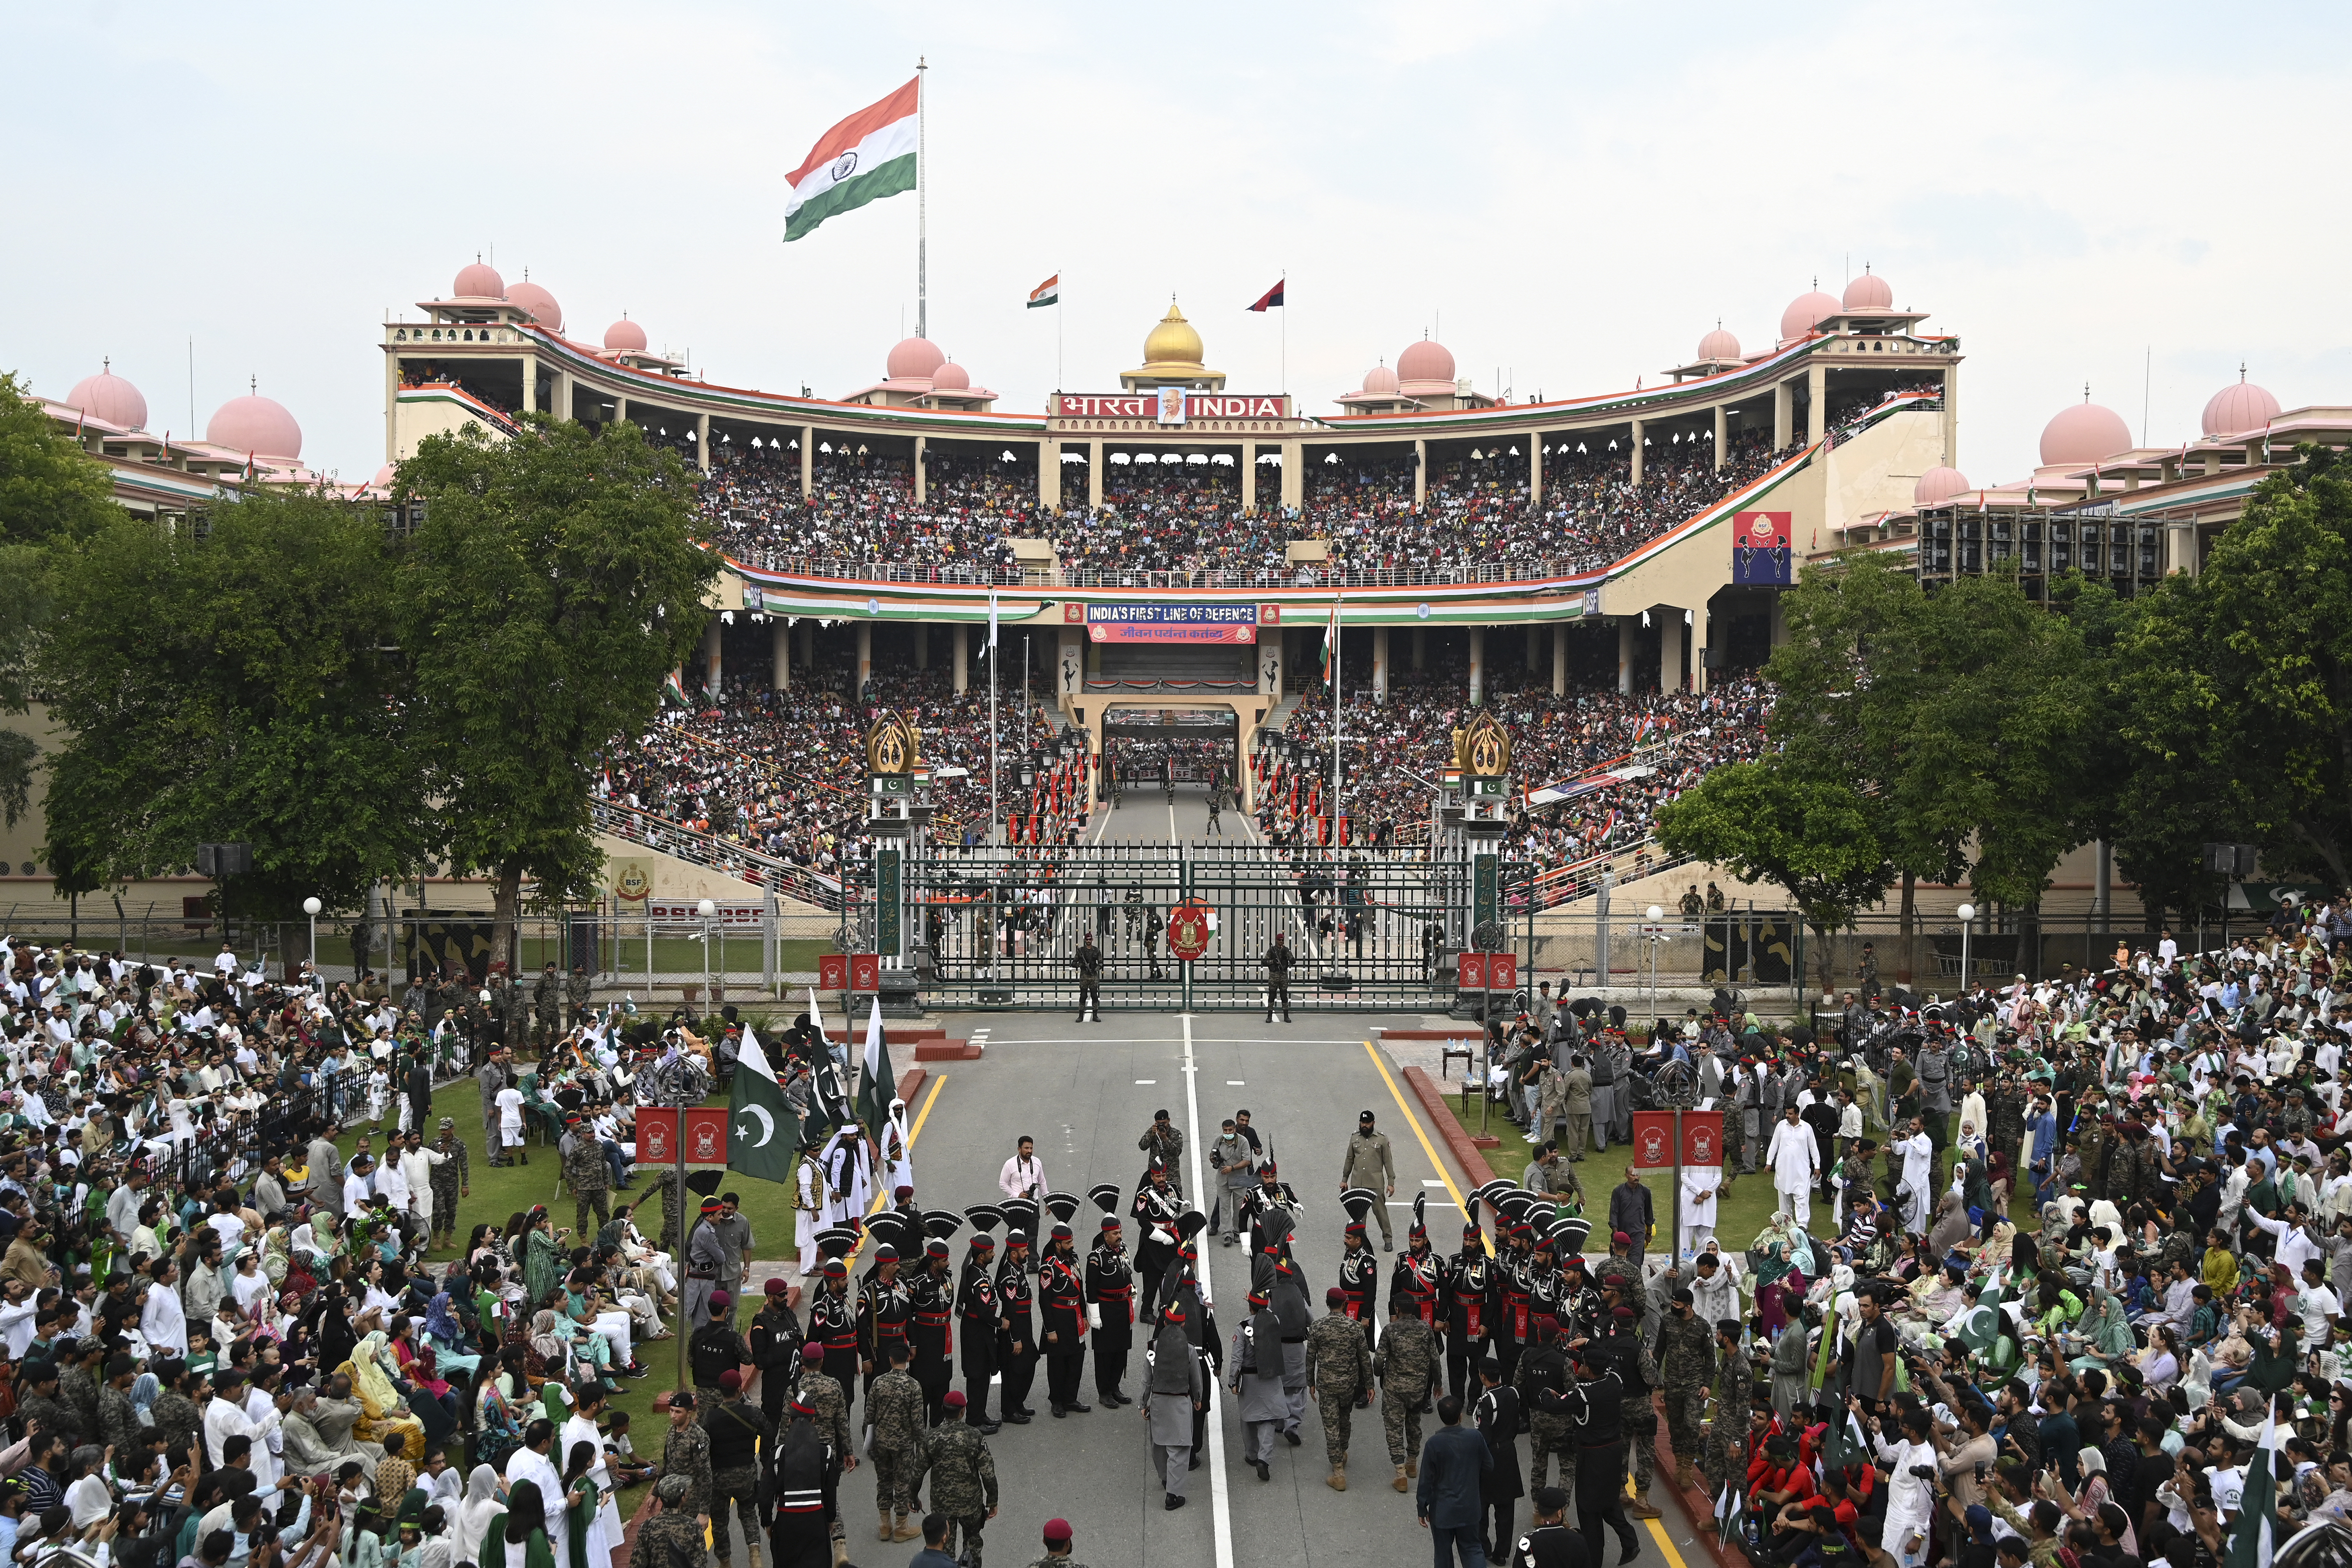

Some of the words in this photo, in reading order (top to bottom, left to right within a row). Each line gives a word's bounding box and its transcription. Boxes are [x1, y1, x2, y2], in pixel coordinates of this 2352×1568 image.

[1063, 397, 1148, 415] भारत
[1194, 398, 1279, 416] INDIA
[750, 587, 761, 606] BSF
[1586, 592, 1597, 611] BSF
[1090, 606, 1128, 620] INDIA'S
[1130, 607, 1161, 620] FIRST
[1164, 607, 1187, 621] LINE
[1189, 607, 1203, 621] OF
[1205, 607, 1253, 621] DEFENCE
[1120, 626, 1153, 637] जीवन
[1154, 627, 1187, 638] पर्यन्त
[1189, 627, 1223, 638] कर्तव्य
[702, 1345, 723, 1354] SORT
